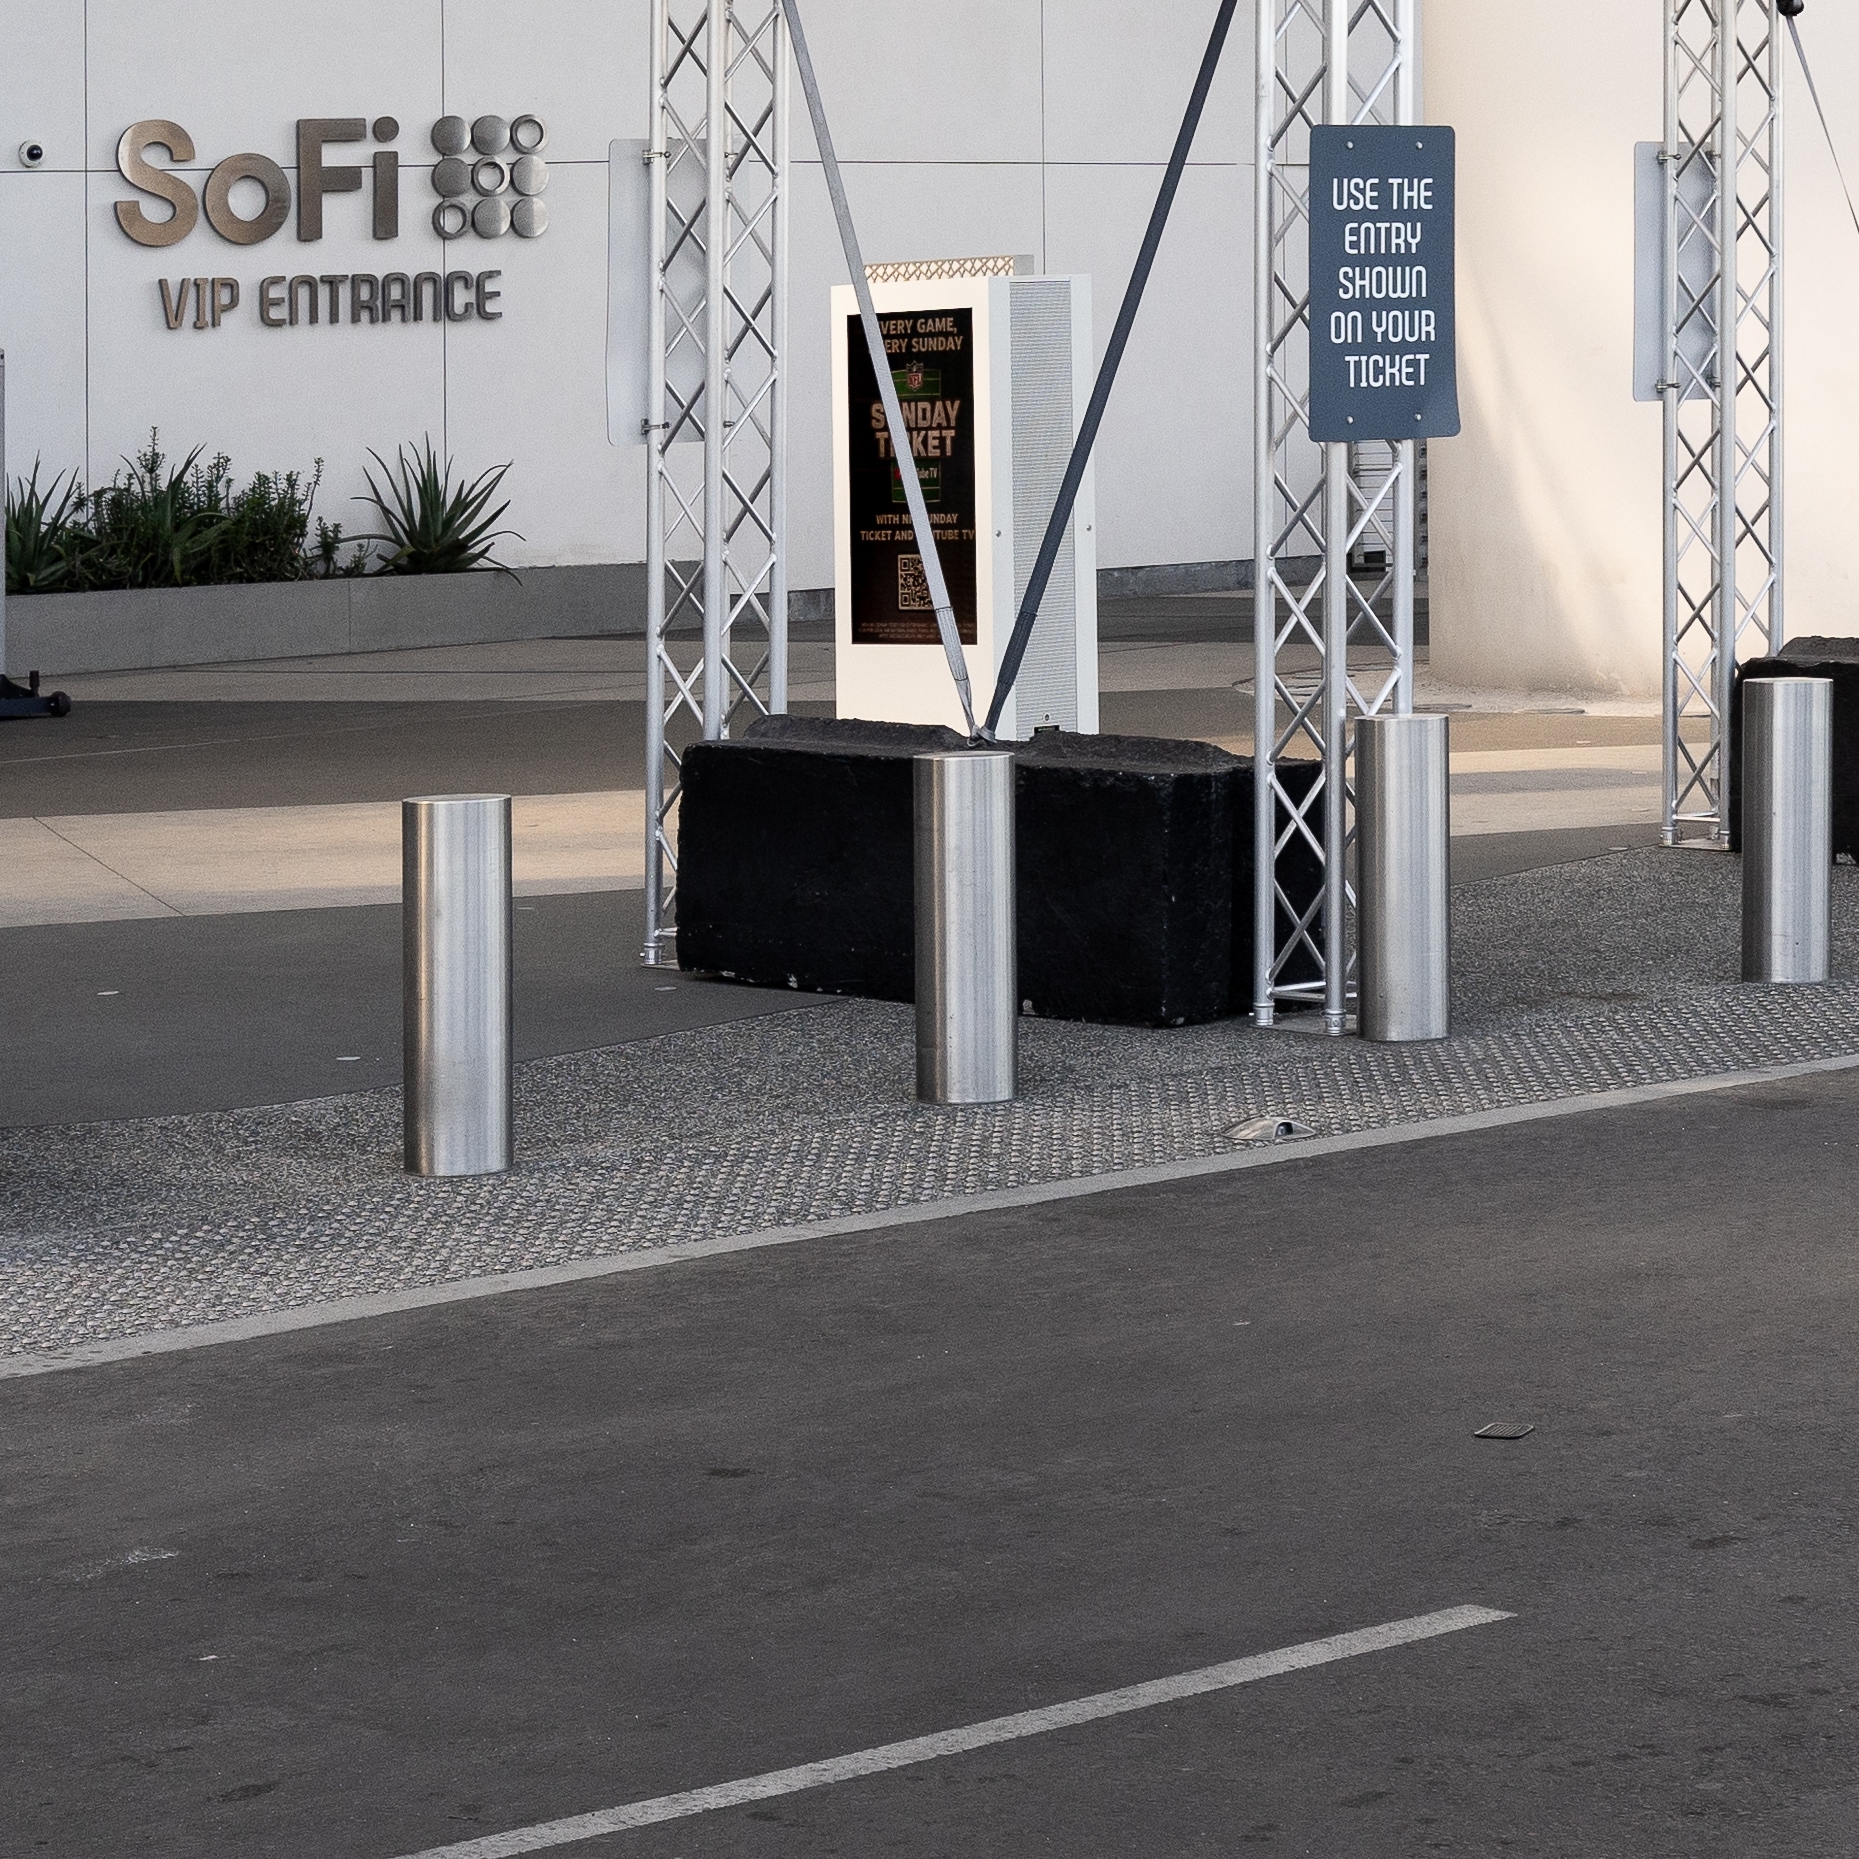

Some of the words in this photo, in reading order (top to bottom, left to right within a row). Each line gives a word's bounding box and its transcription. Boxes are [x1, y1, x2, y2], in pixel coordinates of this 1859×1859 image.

[115, 116, 400, 247] SoFi
[1333, 178, 1380, 211] USE
[1388, 178, 1434, 210] THE
[1345, 222, 1421, 255] ENTRY
[1339, 266, 1427, 299] SHOWN
[158, 278, 240, 330] VIP
[259, 270, 503, 328] ENTRANCE
[879, 320, 913, 334] VERY
[917, 318, 957, 334] GAME,
[1331, 311, 1362, 344] ON
[1372, 310, 1436, 343] YOUR
[884, 339, 908, 353] ERY
[912, 336, 963, 352] SUNDAY
[1345, 354, 1430, 388] TICKET
[871, 401, 960, 429] SNDAY
[875, 430, 956, 457] TKET
[860, 531, 892, 541] TICKET
[894, 530, 914, 540] AND
[932, 530, 959, 539] TUBE
[876, 515, 900, 524] WITH
[930, 514, 958, 523] UNDAY
